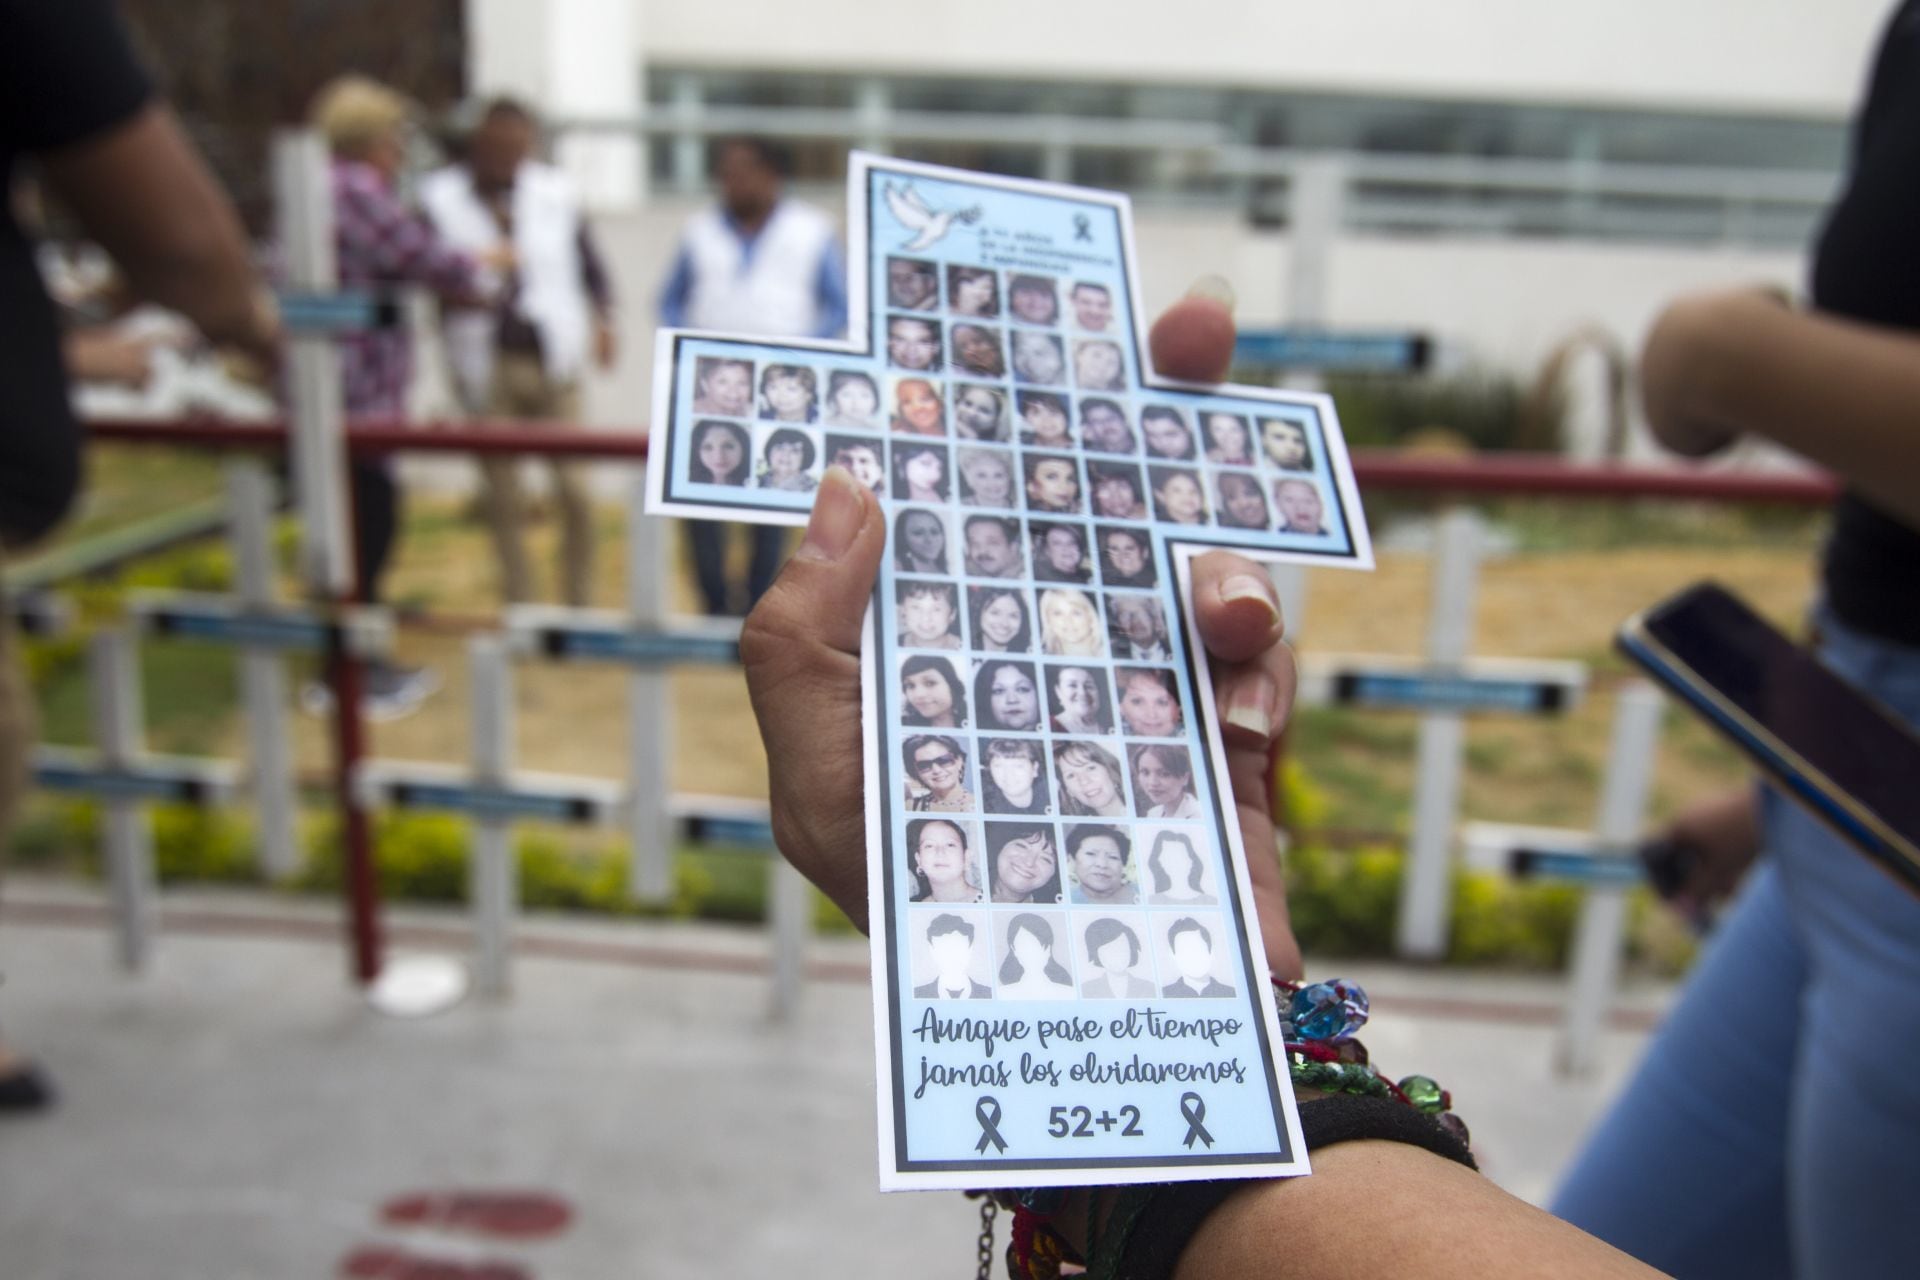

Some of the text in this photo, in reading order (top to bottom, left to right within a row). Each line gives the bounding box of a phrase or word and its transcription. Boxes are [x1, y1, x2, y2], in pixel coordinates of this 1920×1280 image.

[912, 1007, 1243, 1058] Aunque pase el tiempo
[914, 1051, 1246, 1099] jamas los olvidaremos
[1048, 1104, 1144, 1139] 52+2
